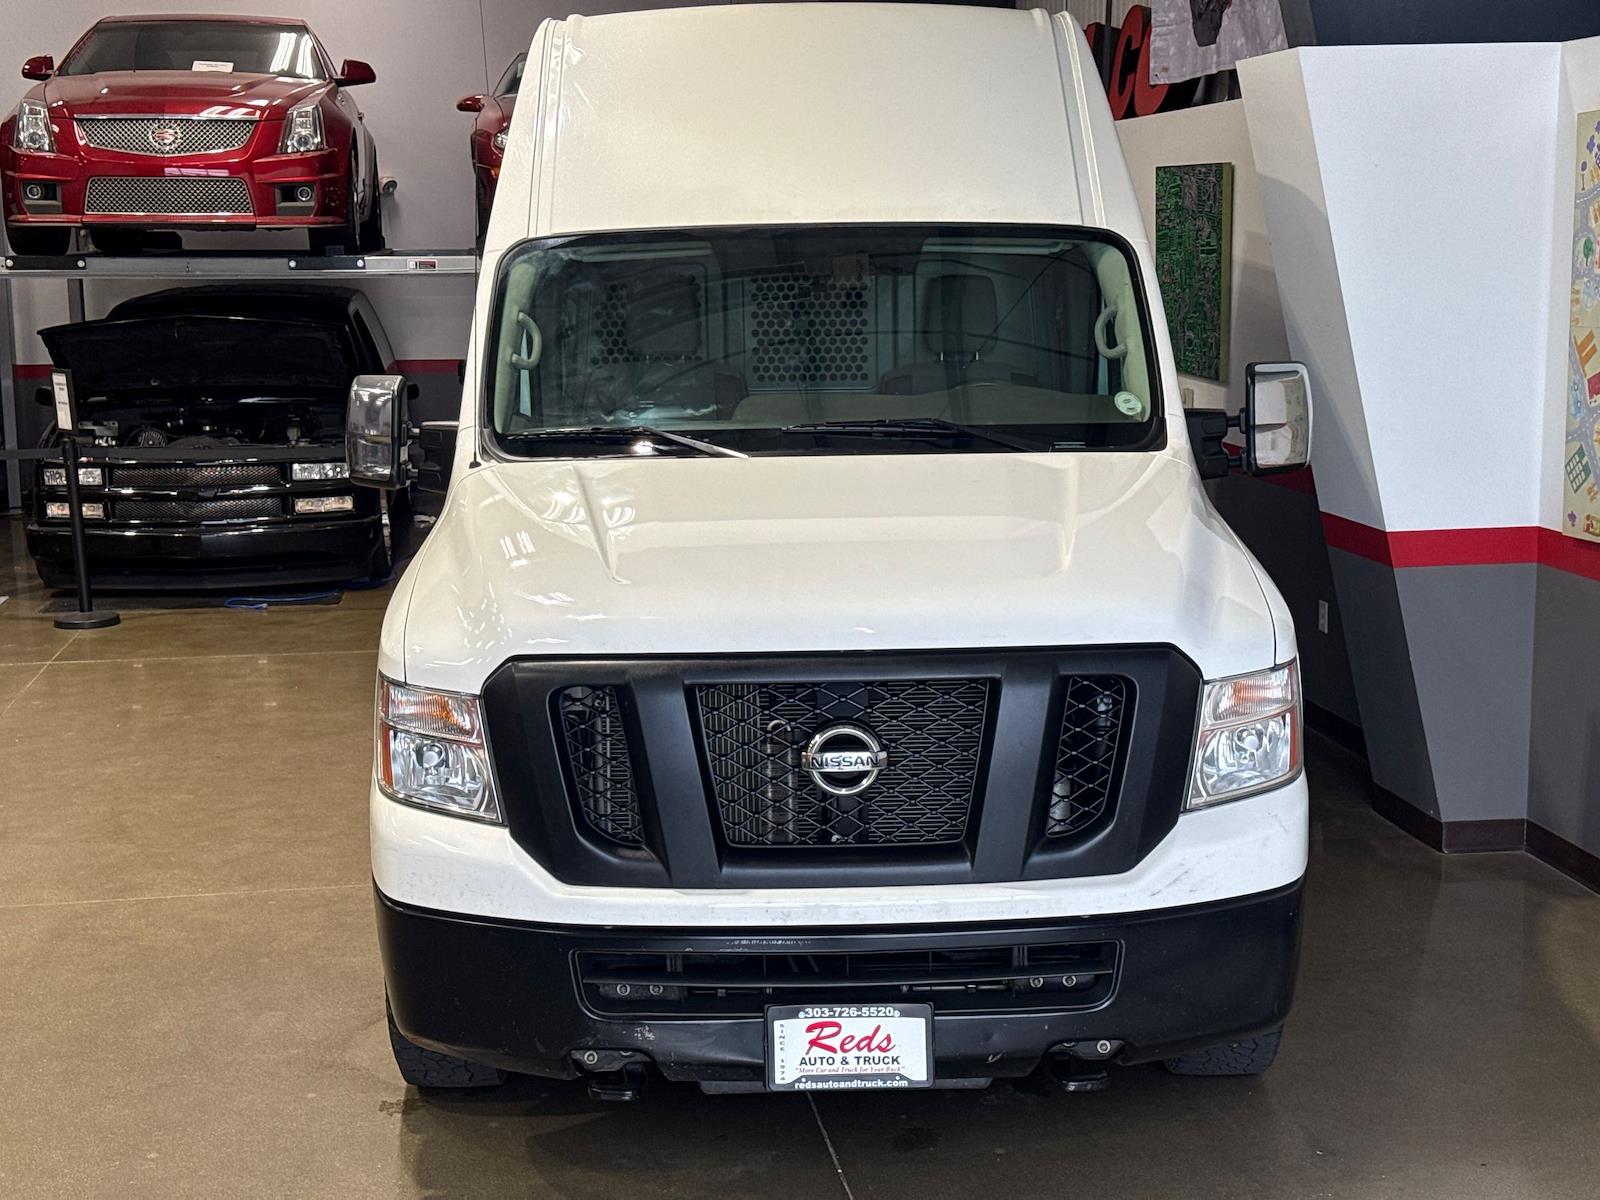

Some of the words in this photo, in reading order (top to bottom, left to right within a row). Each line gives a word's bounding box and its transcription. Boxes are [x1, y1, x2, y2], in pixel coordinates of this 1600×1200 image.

[811, 755, 879, 768] NISSAN
[805, 1007, 894, 1017] 303-726-5520
[805, 1021, 896, 1056] Reds
[799, 1056, 836, 1066] AUTO
[840, 1056, 849, 1066] &
[854, 1055, 901, 1066] TRUCK
[794, 1079, 909, 1089] redsautoandtruck.com
